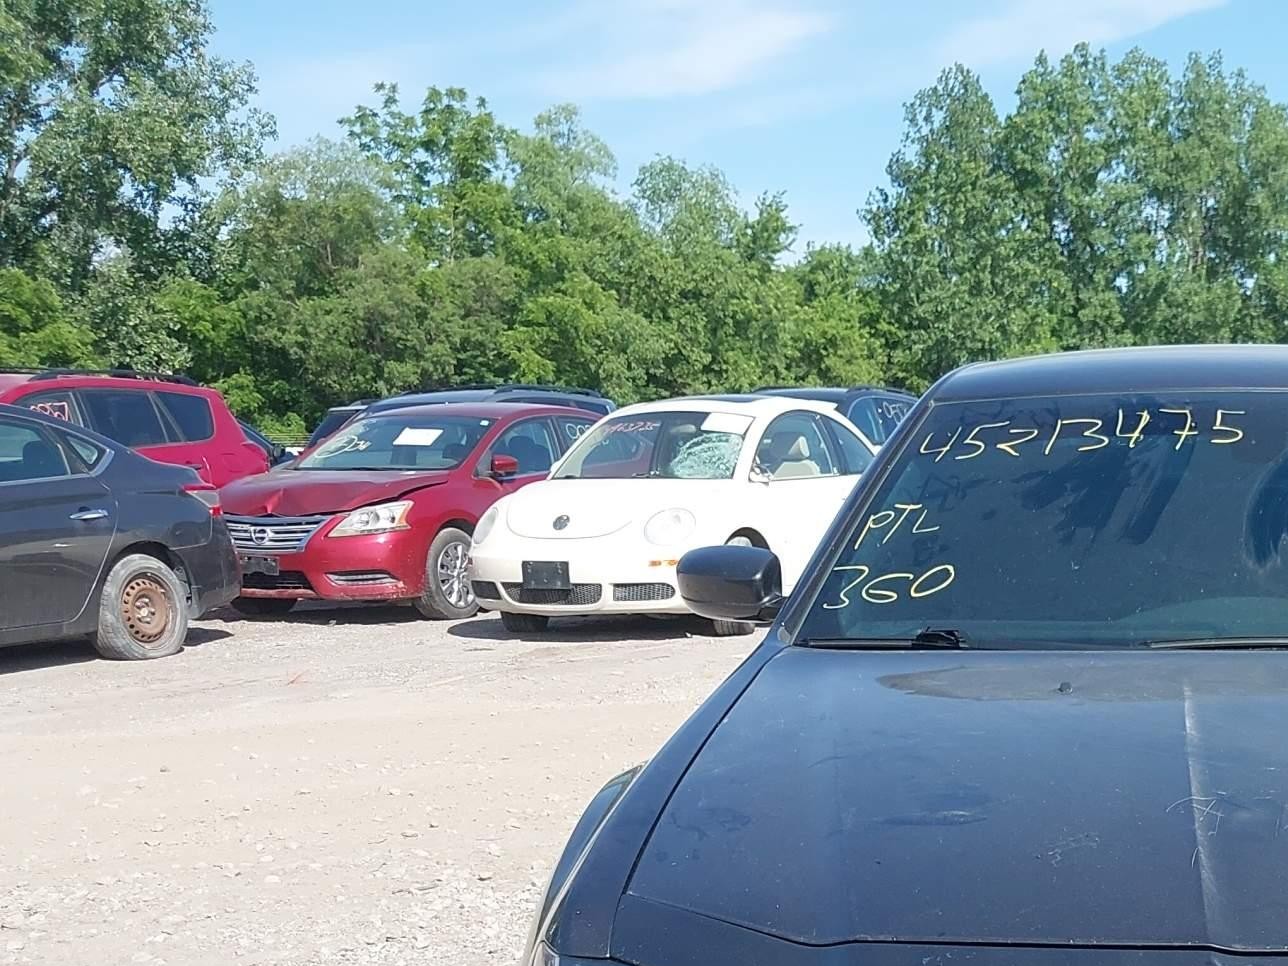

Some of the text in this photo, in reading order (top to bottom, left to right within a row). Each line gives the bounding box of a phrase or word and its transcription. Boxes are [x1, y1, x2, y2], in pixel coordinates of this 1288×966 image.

[919, 408, 1246, 463] 45213475
[853, 503, 941, 550] PTL
[822, 564, 956, 609] 360
